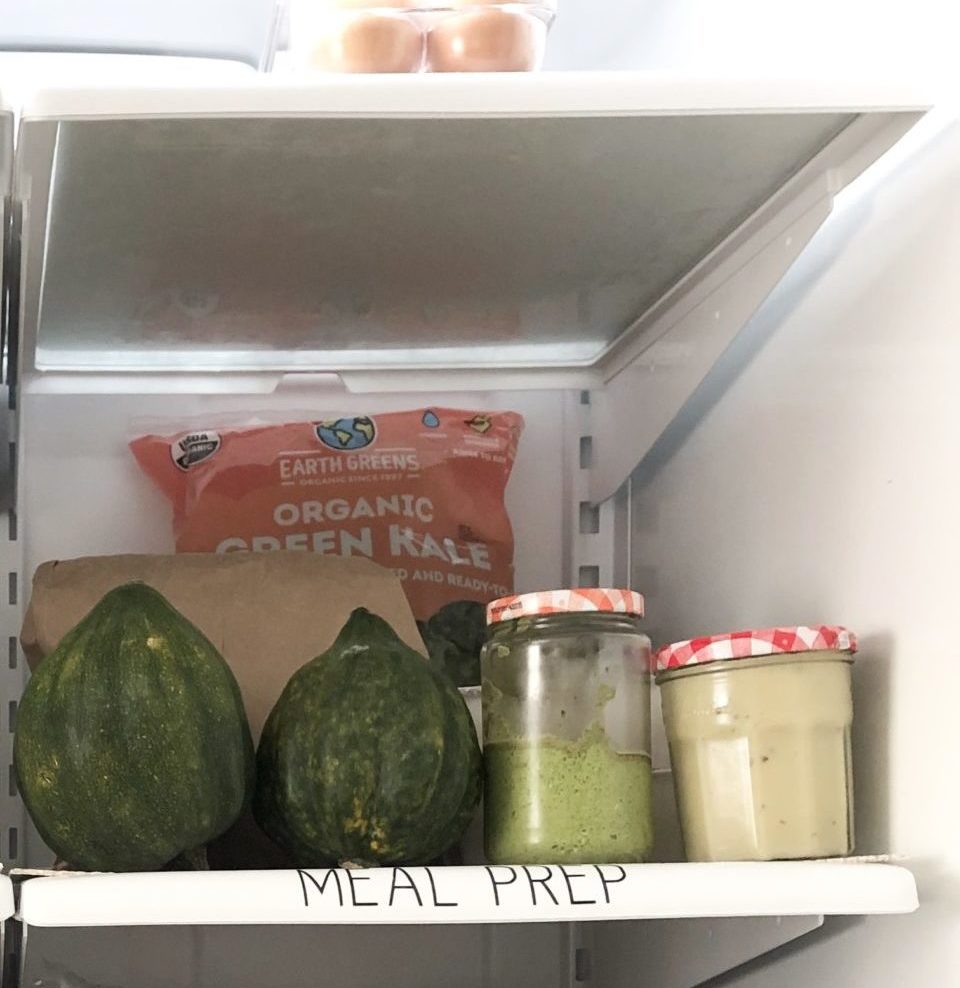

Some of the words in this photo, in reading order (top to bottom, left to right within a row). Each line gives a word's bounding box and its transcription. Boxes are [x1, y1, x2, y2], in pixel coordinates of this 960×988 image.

[280, 457, 342, 480] EARTH
[347, 454, 420, 472] GREENS
[273, 494, 433, 526] ORGANIC
[389, 524, 491, 570] KALE
[413, 570, 444, 583] AND
[297, 866, 458, 907] MEAL
[485, 865, 626, 906] PREP
